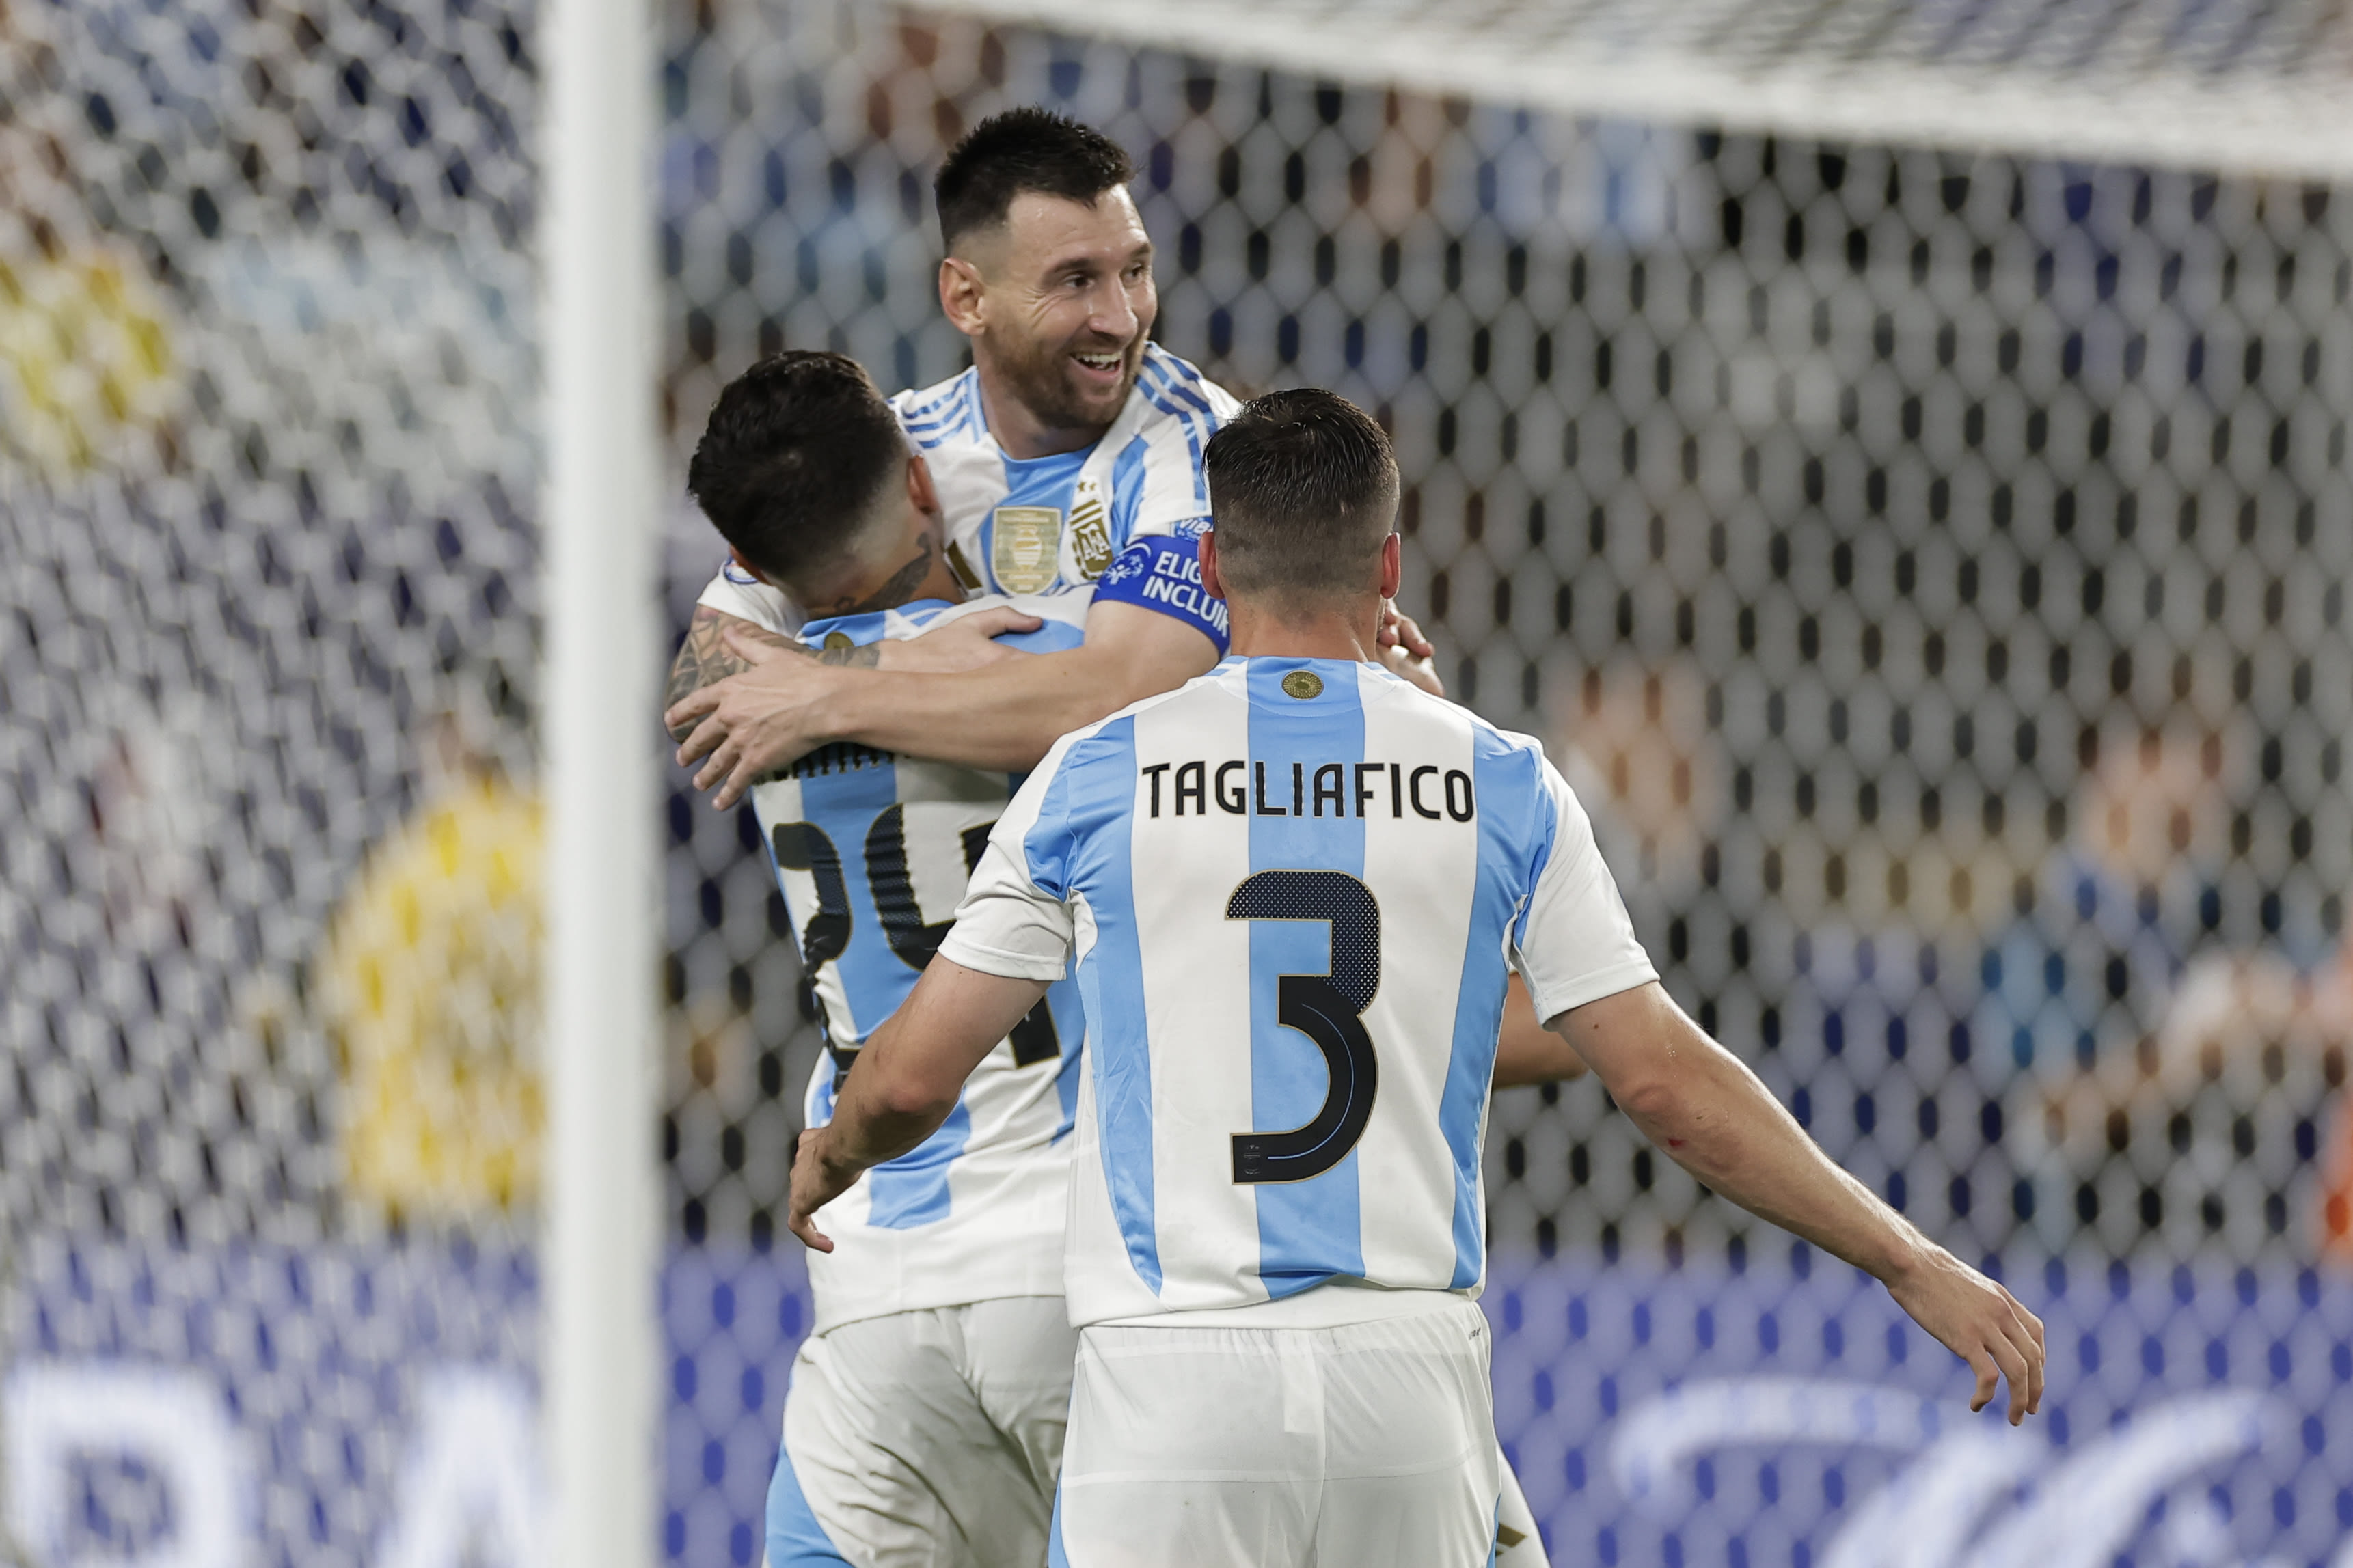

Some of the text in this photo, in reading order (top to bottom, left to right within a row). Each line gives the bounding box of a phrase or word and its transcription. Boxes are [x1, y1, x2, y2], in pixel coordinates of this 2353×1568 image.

[1179, 519, 1214, 534] VIB
[1142, 760, 1474, 823] TAGLIAFICO
[1225, 869, 1380, 1185] 3
